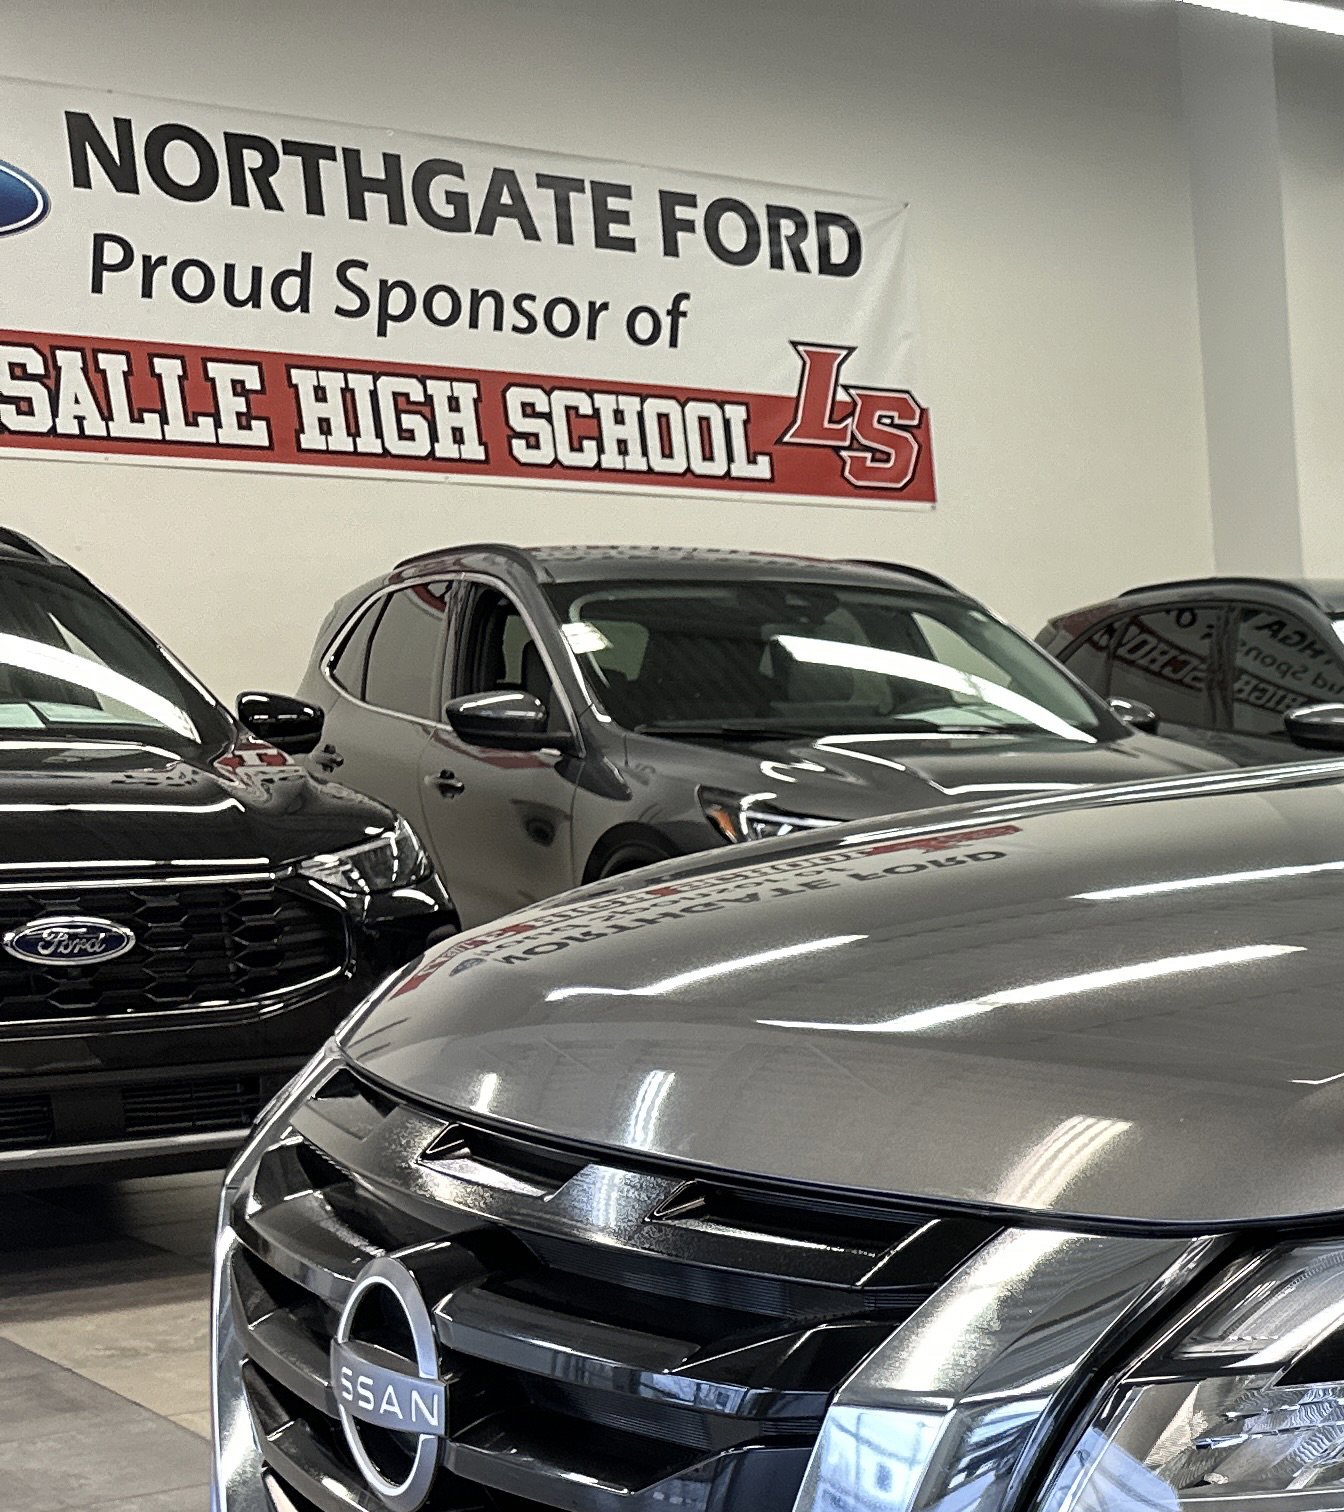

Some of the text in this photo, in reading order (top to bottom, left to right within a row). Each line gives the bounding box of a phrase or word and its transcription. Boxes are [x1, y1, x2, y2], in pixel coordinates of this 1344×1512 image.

[64, 111, 864, 279] NORTHGATE FORD
[89, 232, 690, 349] Proud Sponsor of
[0, 342, 773, 482] SALLE HIGH SCHOOL
[774, 340, 925, 490] LS
[37, 927, 107, 956] Ford
[340, 1365, 439, 1427] SSAN
